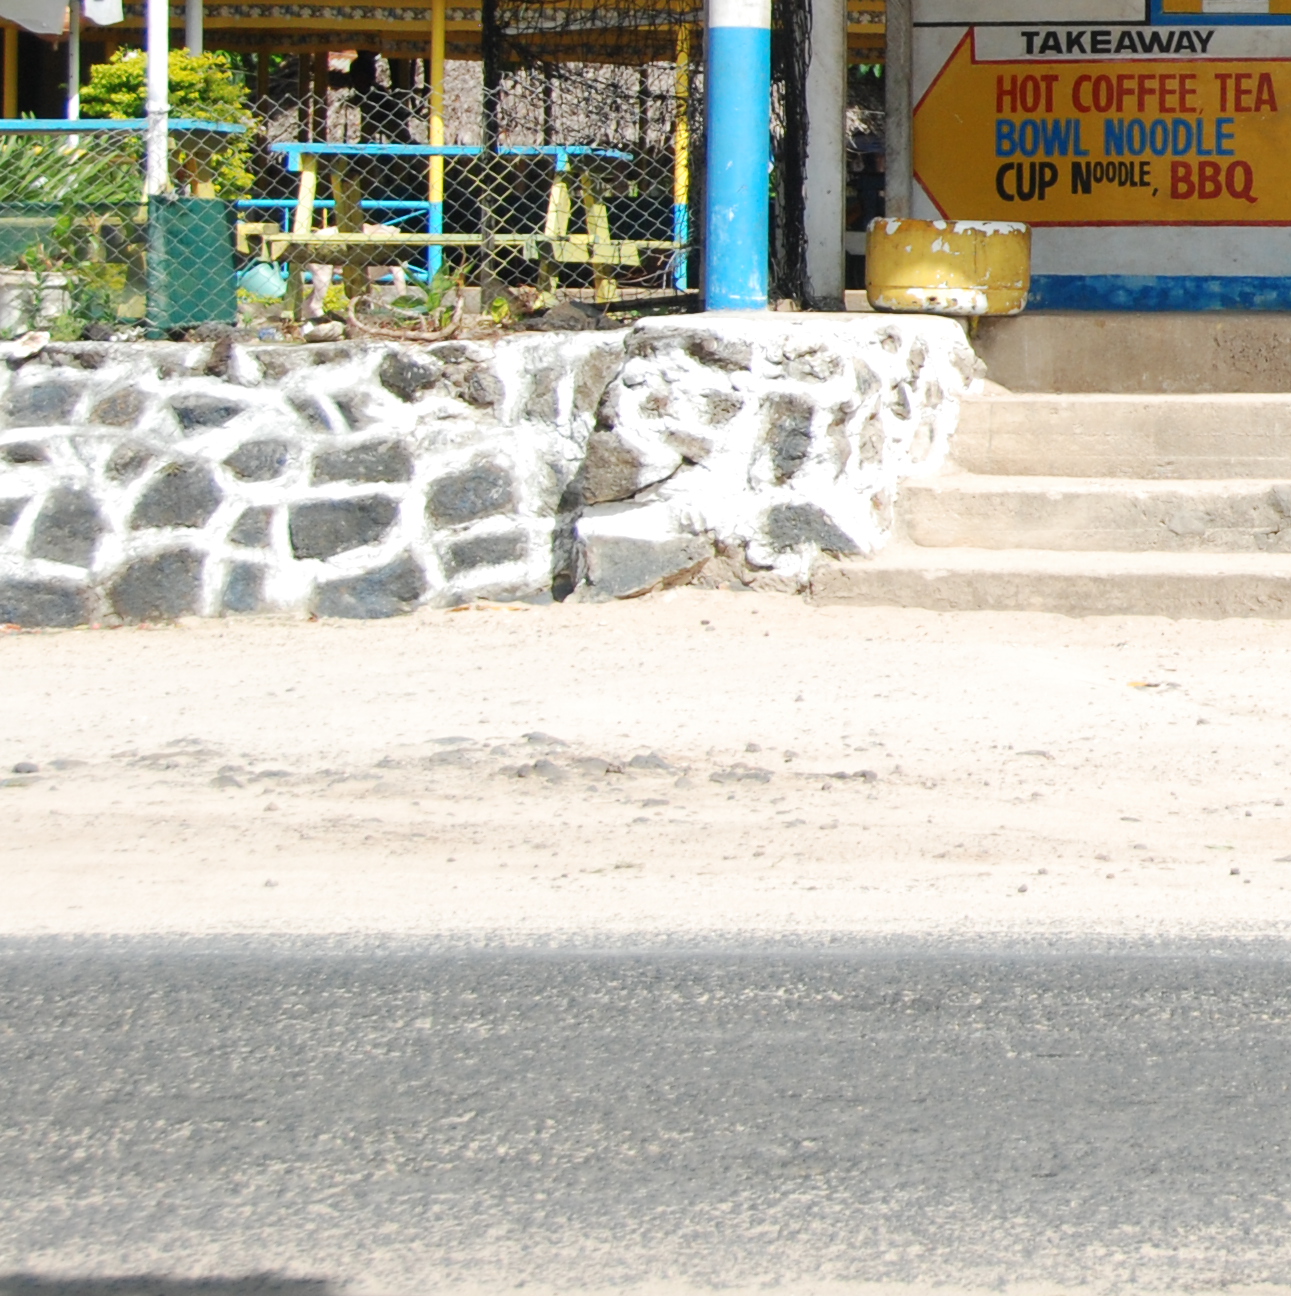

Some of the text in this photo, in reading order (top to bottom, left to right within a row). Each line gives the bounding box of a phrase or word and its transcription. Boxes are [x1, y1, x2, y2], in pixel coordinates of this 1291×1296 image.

[1021, 30, 1215, 55] TAKEAWAY
[996, 74, 1059, 114] HOT
[1215, 72, 1278, 113] TEA
[995, 117, 1236, 157] BOWL NOODLE
[996, 161, 1058, 201] CUP
[1170, 160, 1259, 204] BBQ
